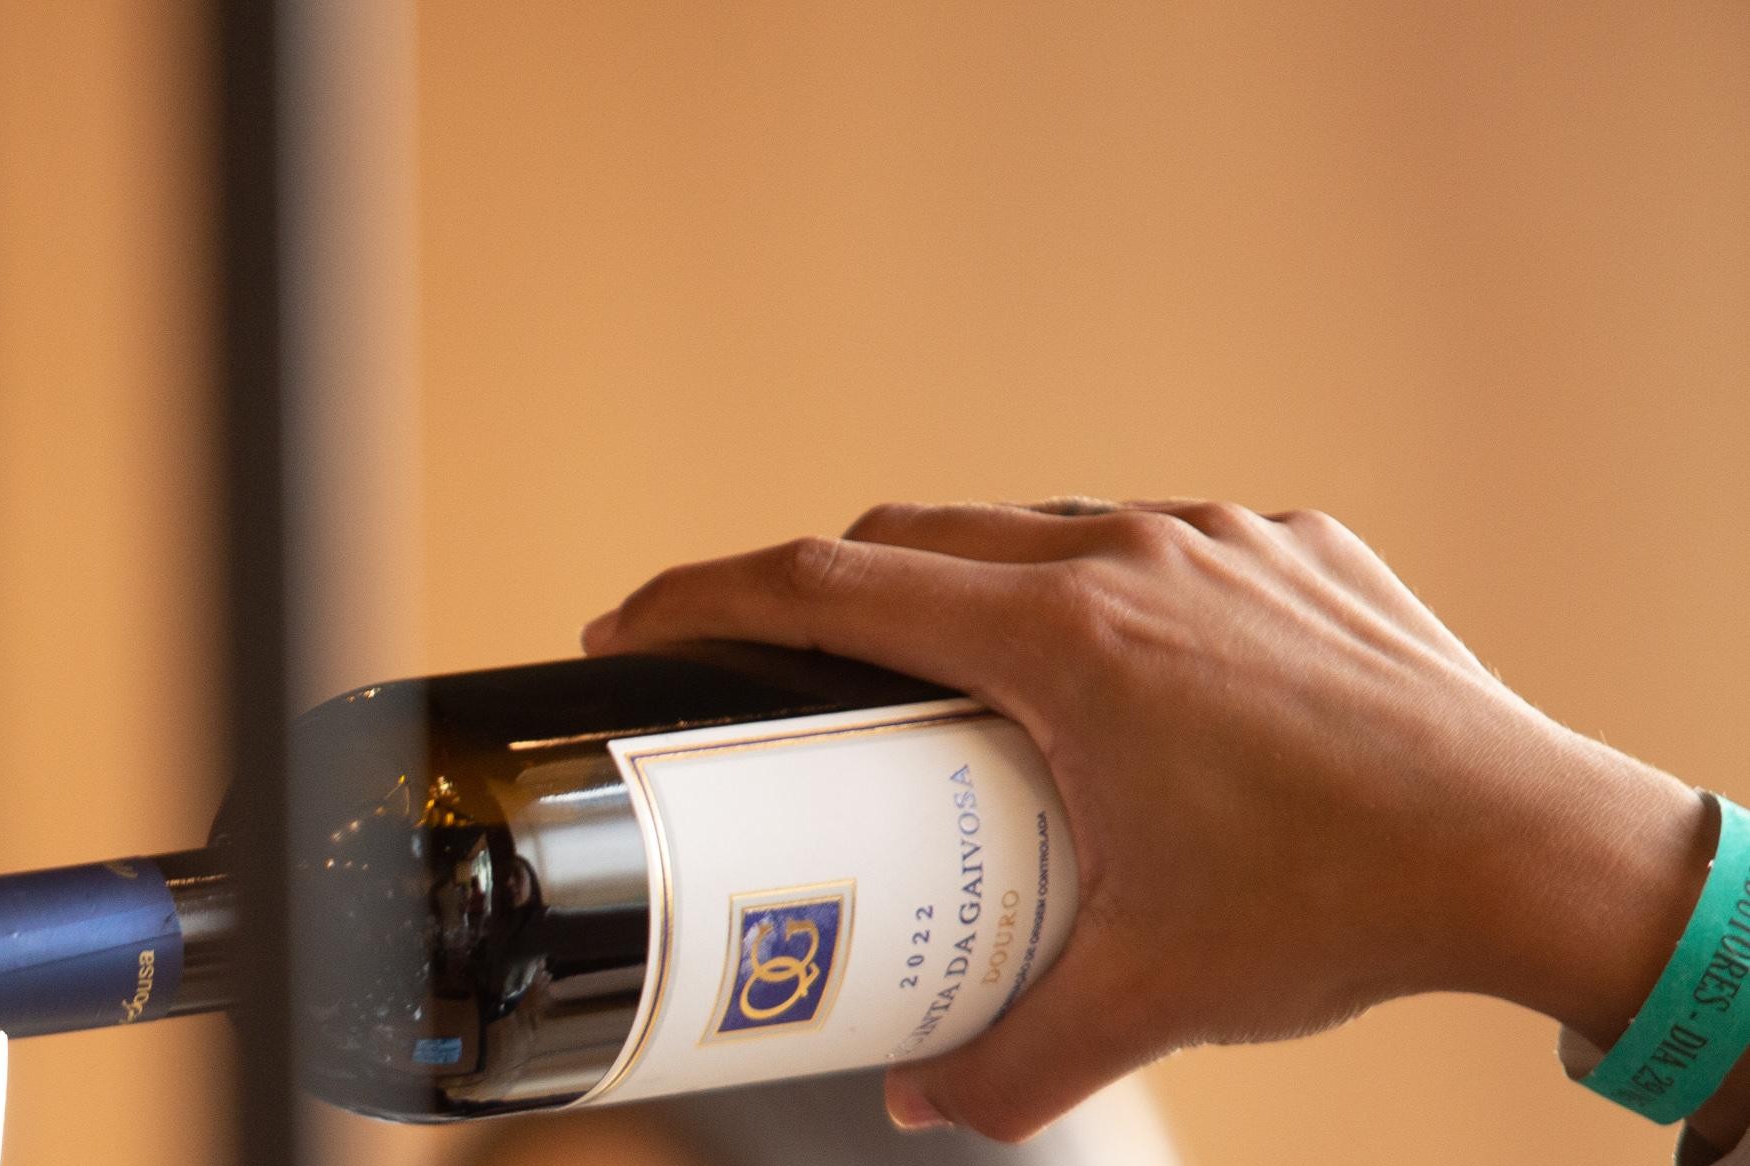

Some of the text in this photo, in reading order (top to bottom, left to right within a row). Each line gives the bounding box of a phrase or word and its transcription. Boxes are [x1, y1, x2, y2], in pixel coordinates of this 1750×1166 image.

[950, 764, 983, 925] GAIVOSA
[900, 904, 934, 989] 2022
[945, 932, 976, 983] DA
[982, 889, 1020, 984] DOURO
[1651, 1024, 1708, 1069] DIA
